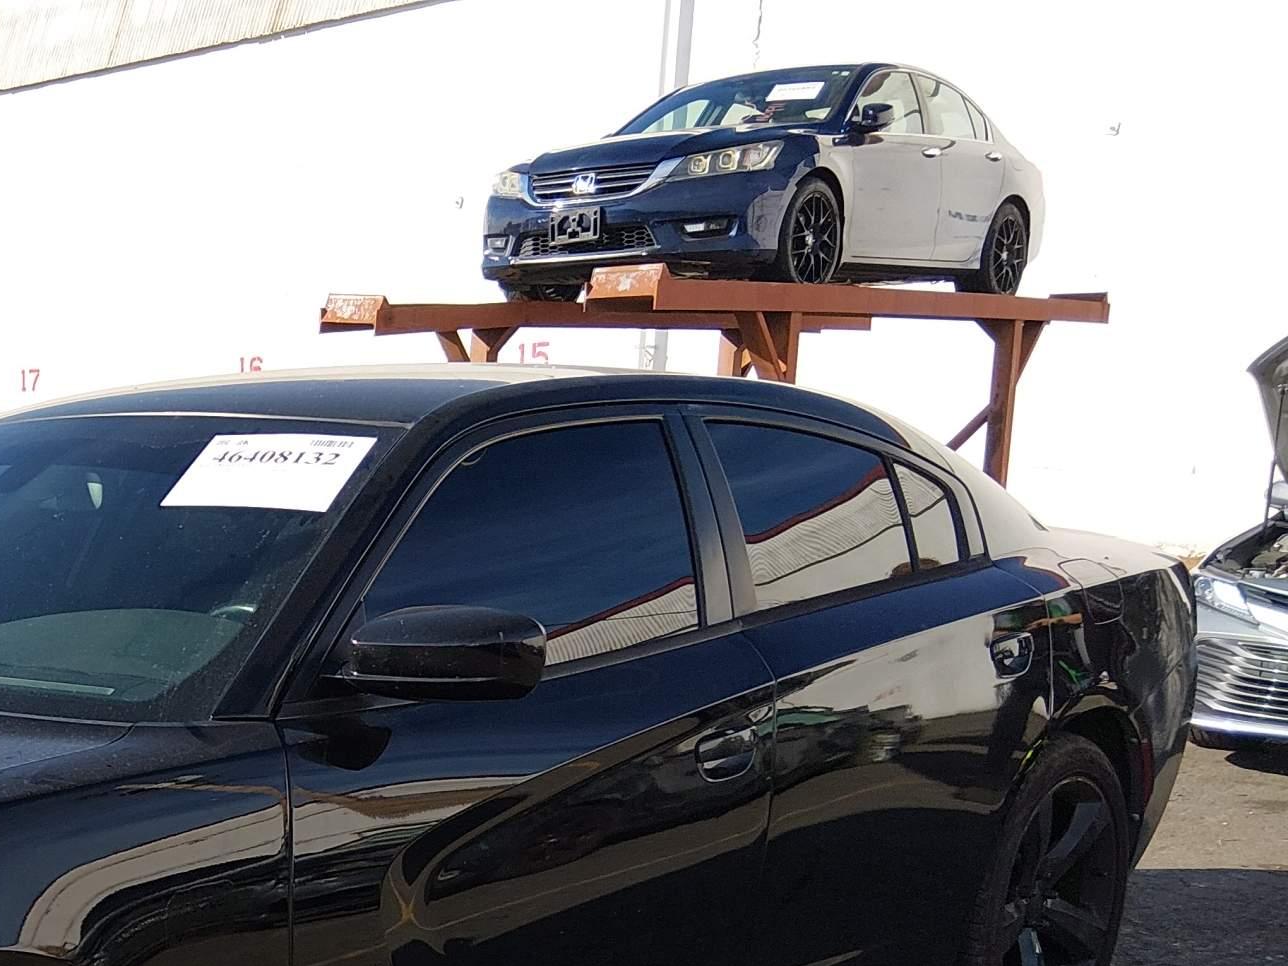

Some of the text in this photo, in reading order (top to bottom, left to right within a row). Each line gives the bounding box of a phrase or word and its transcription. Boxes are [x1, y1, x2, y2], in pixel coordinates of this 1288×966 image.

[518, 341, 550, 365] 15
[21, 368, 40, 392] 17
[212, 449, 341, 465] 46408132
